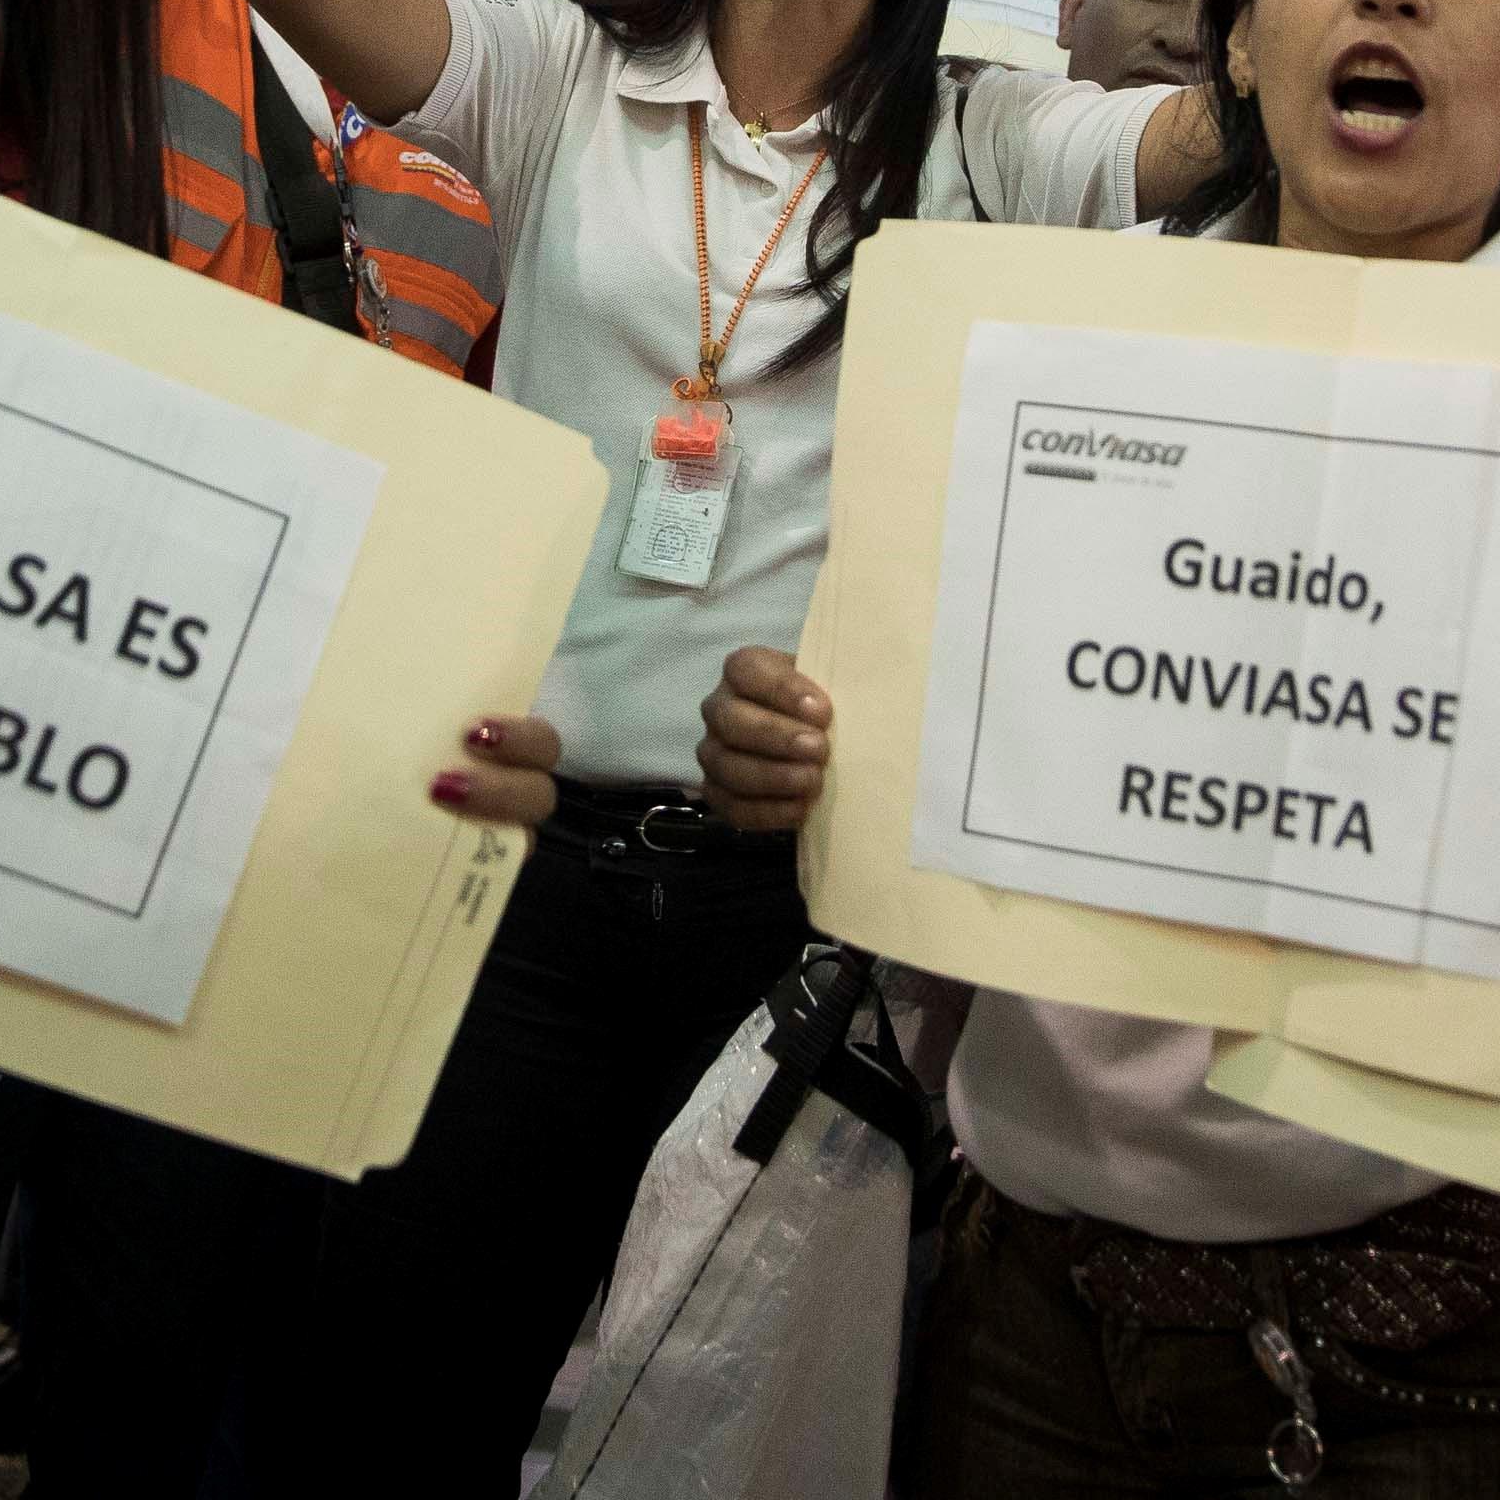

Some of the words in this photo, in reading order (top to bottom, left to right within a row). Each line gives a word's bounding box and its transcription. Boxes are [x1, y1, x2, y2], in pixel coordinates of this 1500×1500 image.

[1163, 537, 1386, 624] Guaido,
[115, 597, 210, 681] ES
[1066, 639, 1374, 733] CONVIASA
[1392, 685, 1461, 746] SE
[1117, 763, 1374, 854] RESPETA
